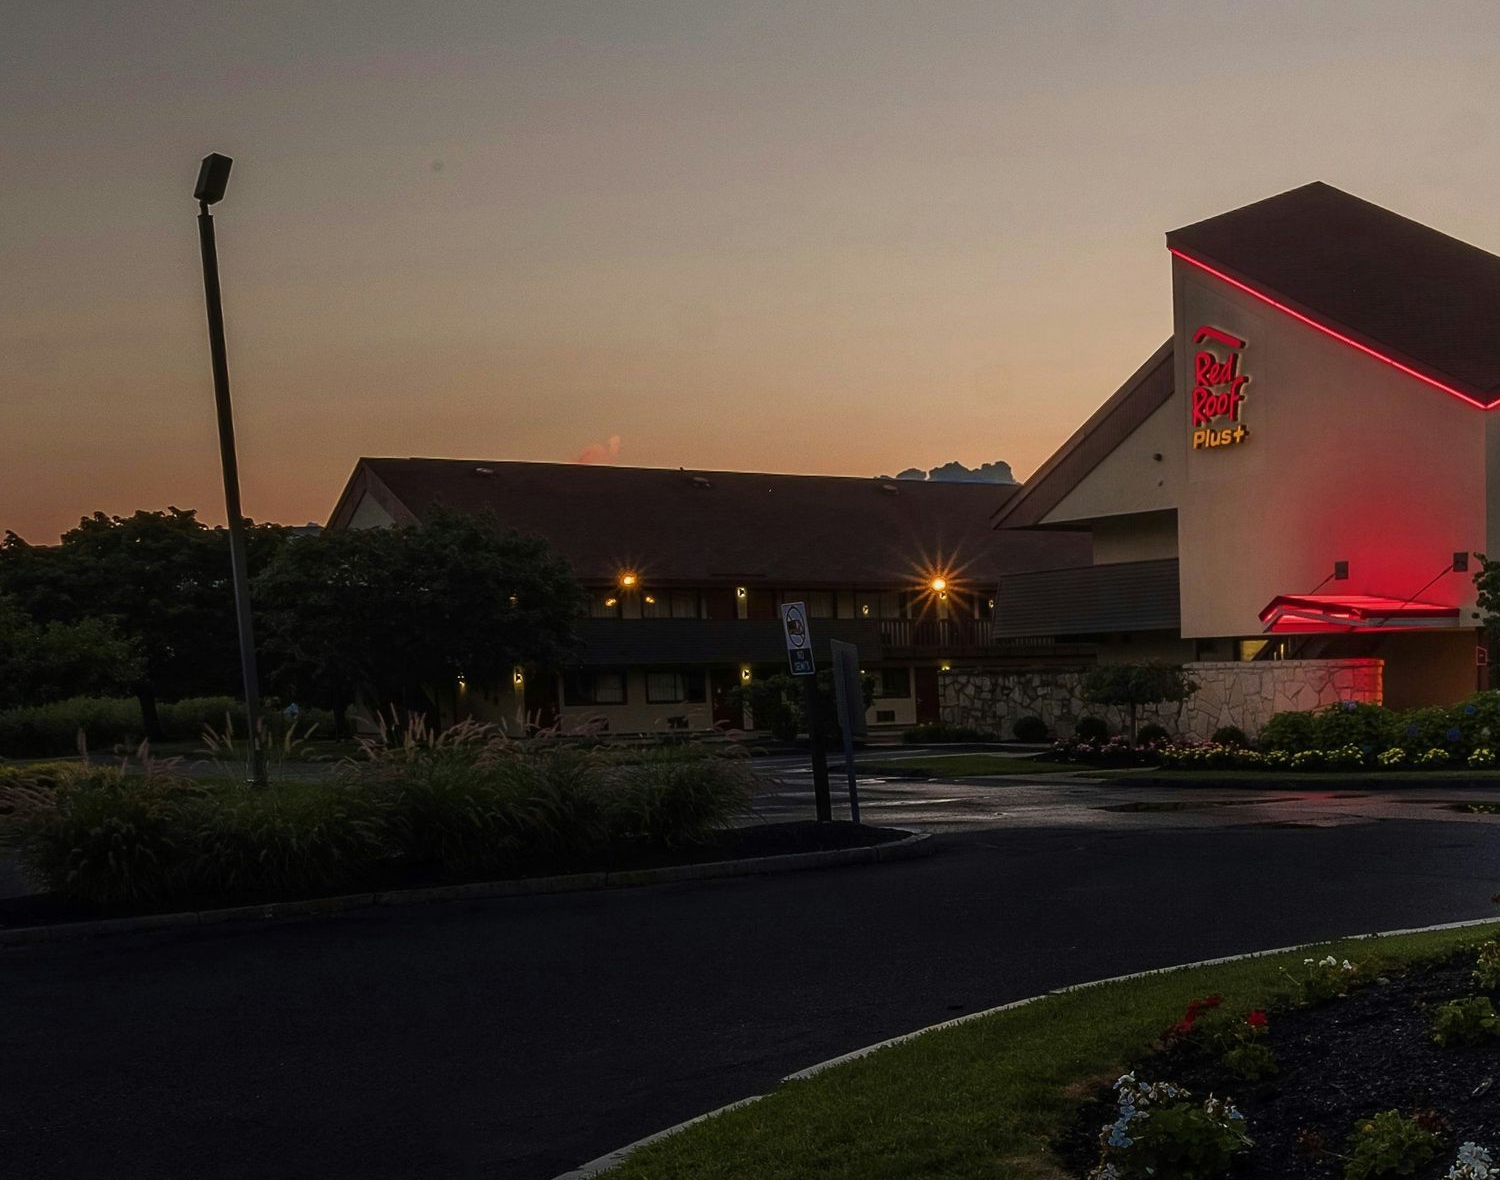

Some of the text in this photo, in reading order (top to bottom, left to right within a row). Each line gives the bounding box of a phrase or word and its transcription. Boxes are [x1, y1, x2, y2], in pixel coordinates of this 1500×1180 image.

[1195, 350, 1238, 386] Red
[1192, 376, 1248, 426] Roof
[1193, 424, 1248, 450] Plus+
